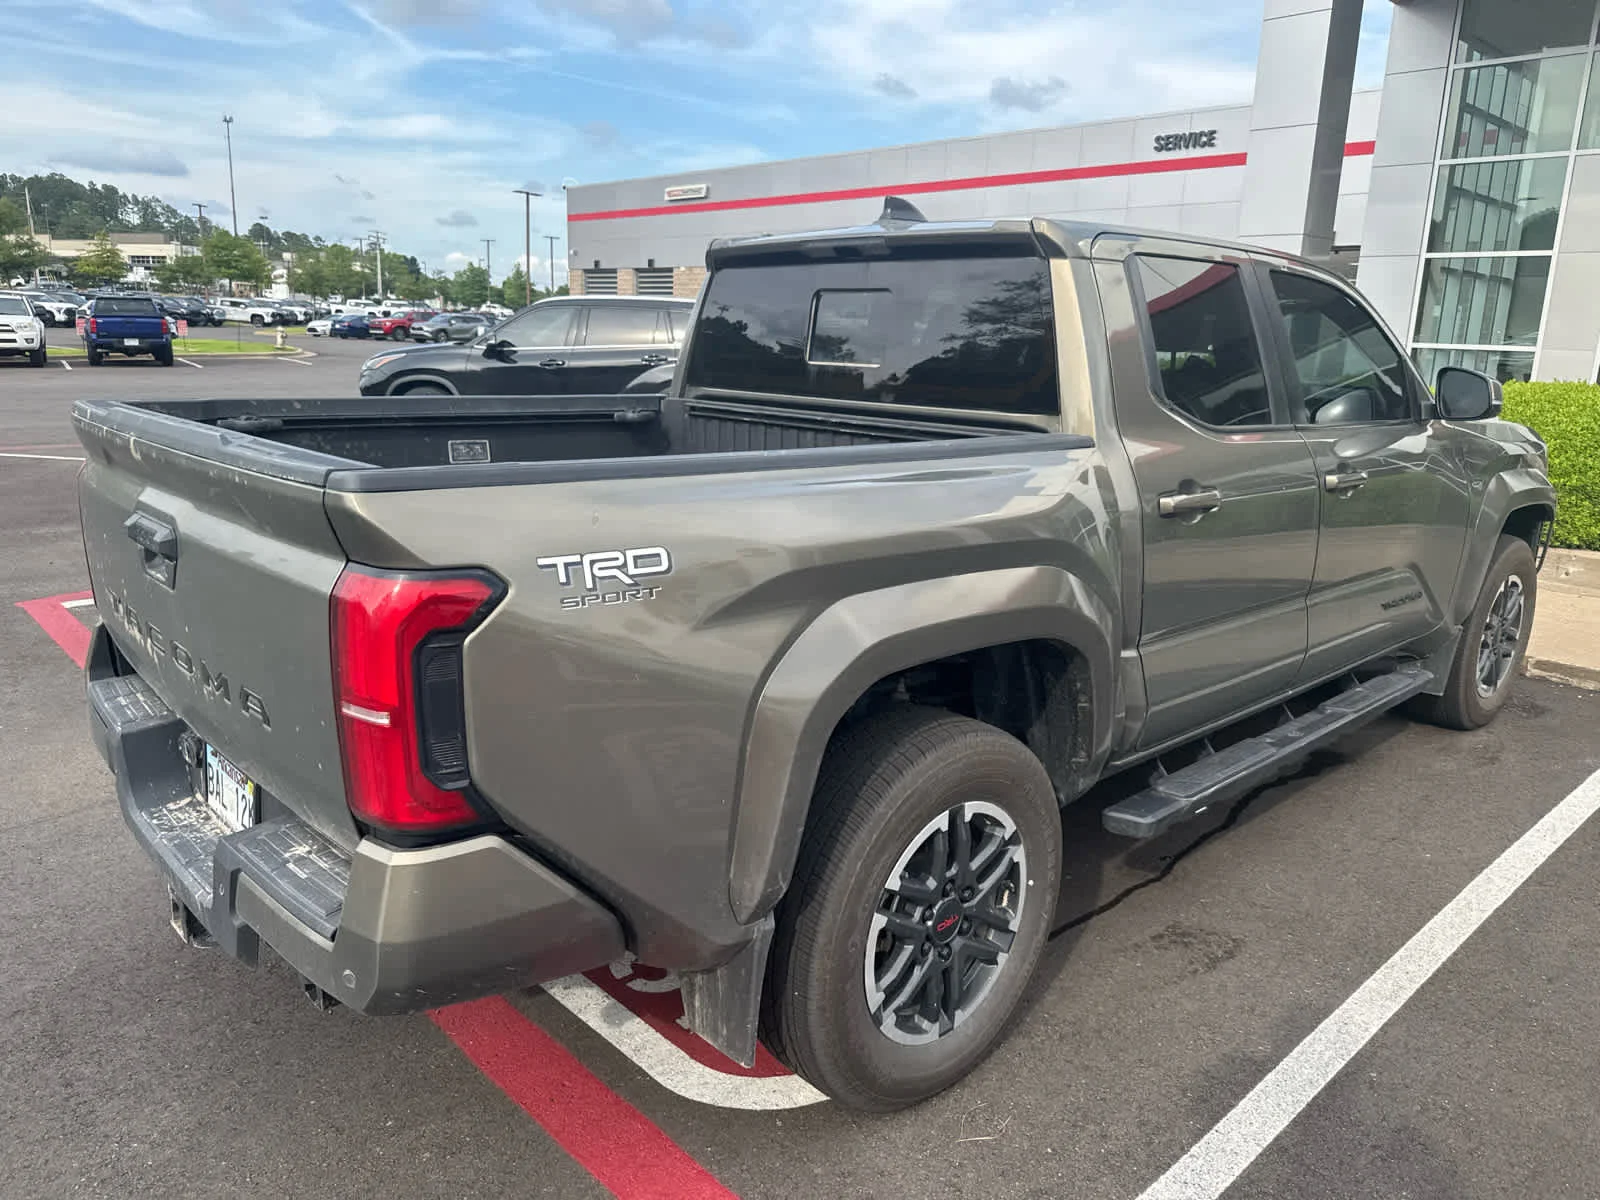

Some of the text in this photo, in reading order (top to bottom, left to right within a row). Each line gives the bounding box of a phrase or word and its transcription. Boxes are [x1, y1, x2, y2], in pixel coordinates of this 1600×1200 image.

[1153, 129, 1217, 152] SERVICE
[536, 545, 673, 592] TRD
[560, 586, 662, 611] SPORT
[105, 585, 272, 732] TACOMA
[208, 762, 228, 810] BAL
